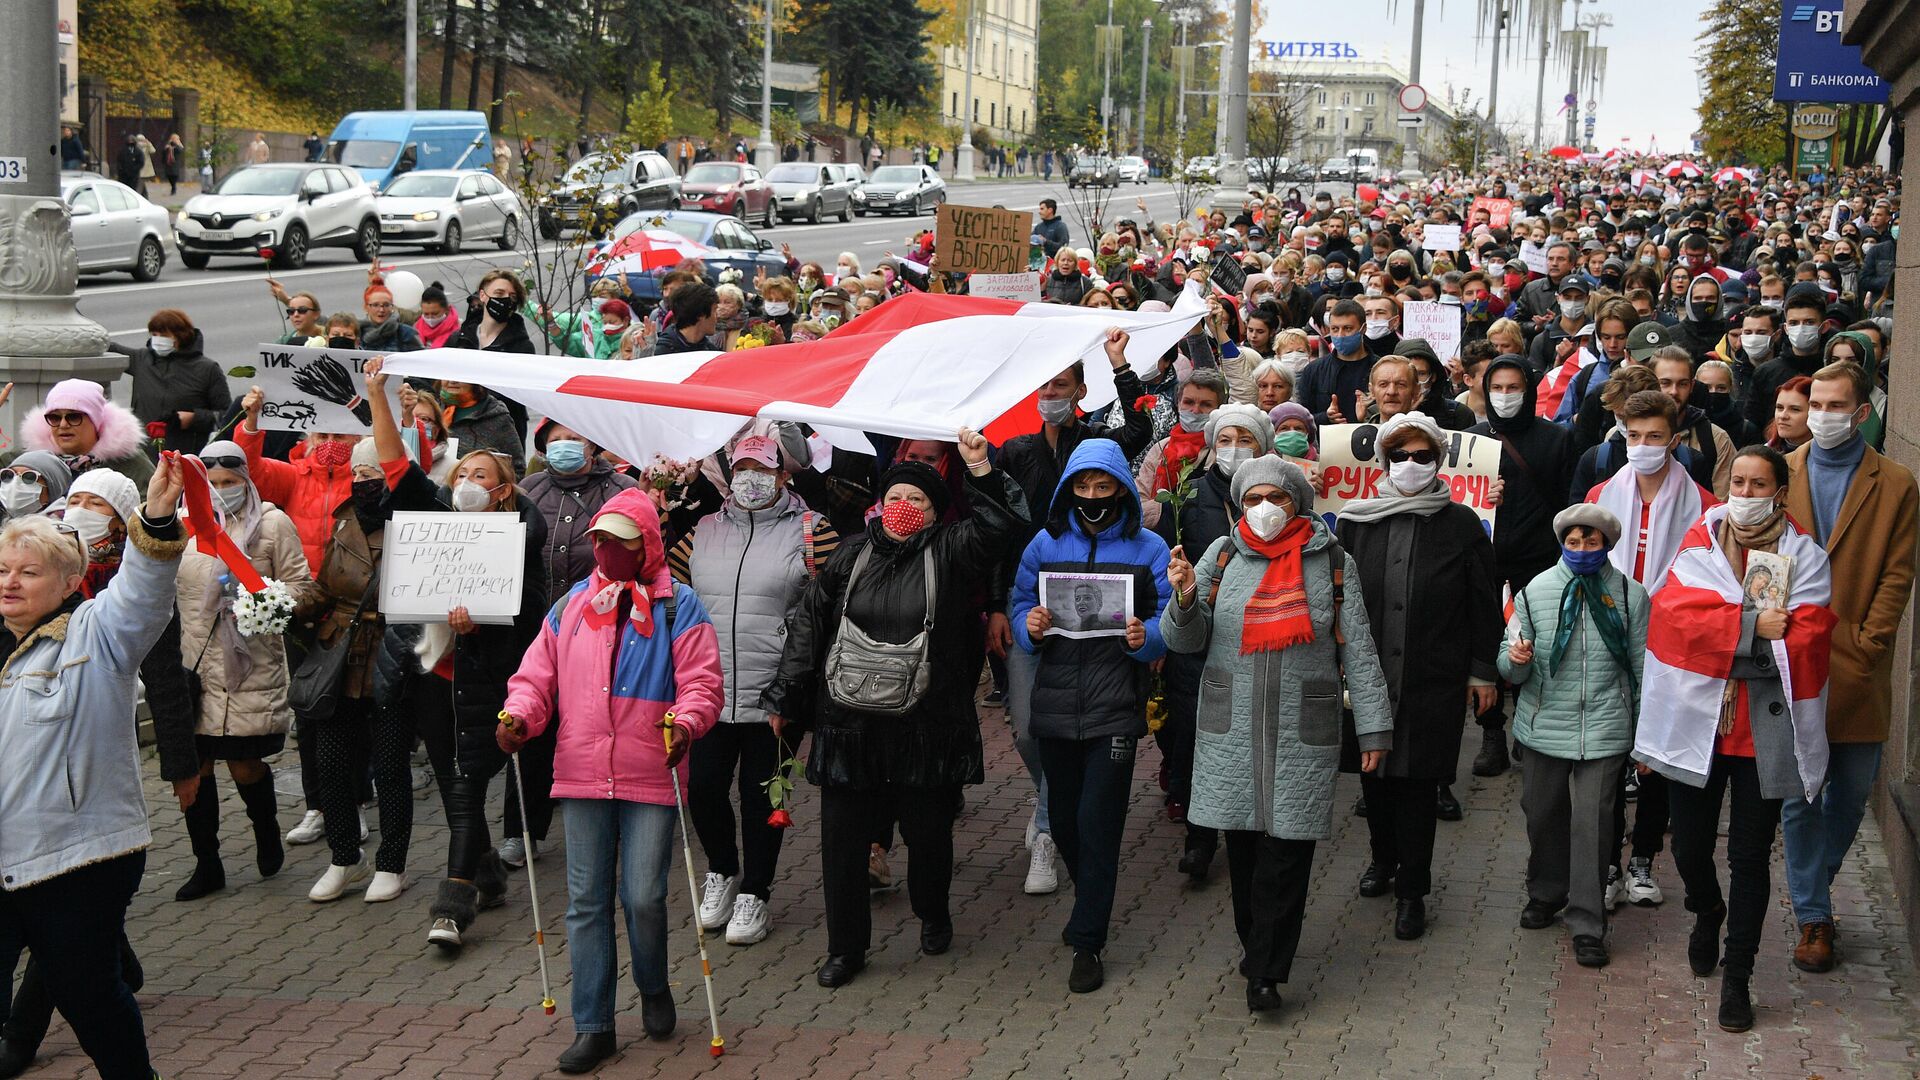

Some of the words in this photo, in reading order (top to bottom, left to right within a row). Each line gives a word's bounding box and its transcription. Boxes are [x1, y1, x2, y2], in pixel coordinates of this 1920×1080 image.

[1811, 75, 1880, 86] БАНКОМАТ
[951, 208, 1021, 243] ЧЕСТНЫЕ
[951, 240, 1021, 274] ВЫБОРЫ
[260, 352, 297, 368] ТИК
[1320, 466, 1390, 500] РУК
[399, 522, 485, 543] ПУТИНУ
[411, 546, 465, 564] РУКИ
